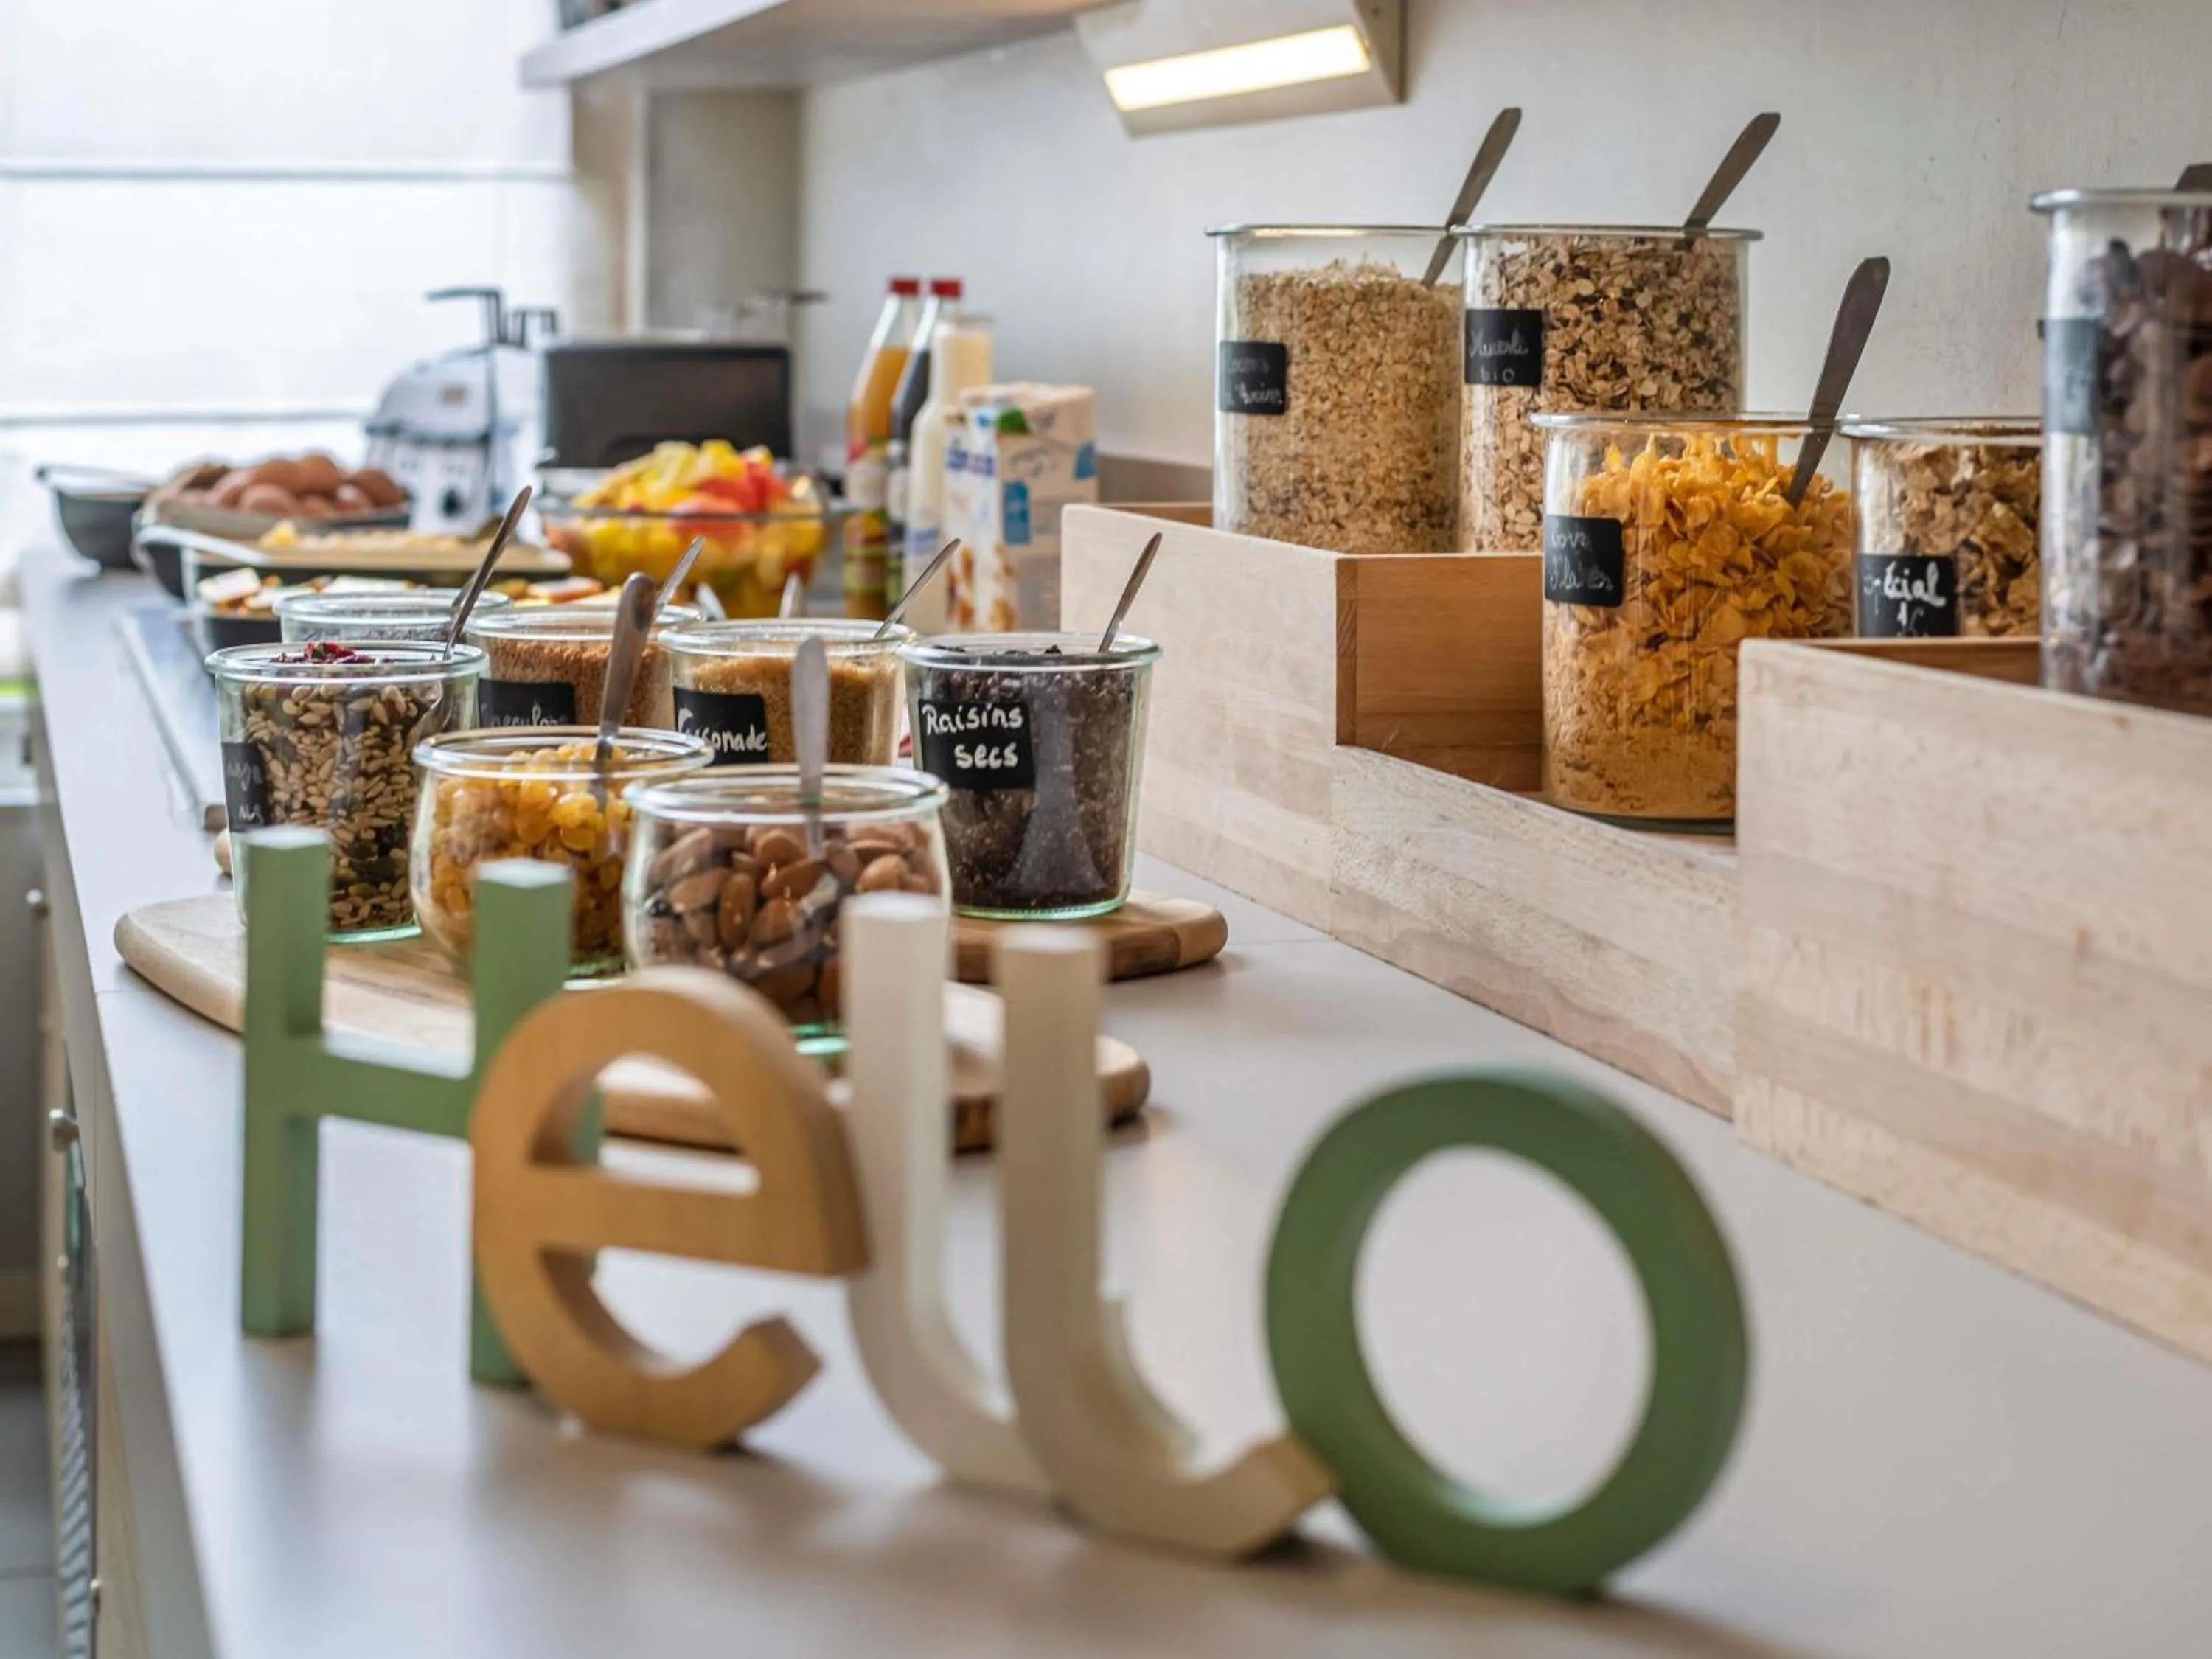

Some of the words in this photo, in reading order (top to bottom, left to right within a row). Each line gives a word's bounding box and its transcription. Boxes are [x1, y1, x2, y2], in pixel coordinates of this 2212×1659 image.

[678, 707, 767, 753] Csonade
[922, 702, 1024, 736] Raisins
[240, 826, 1749, 1596] Hello
